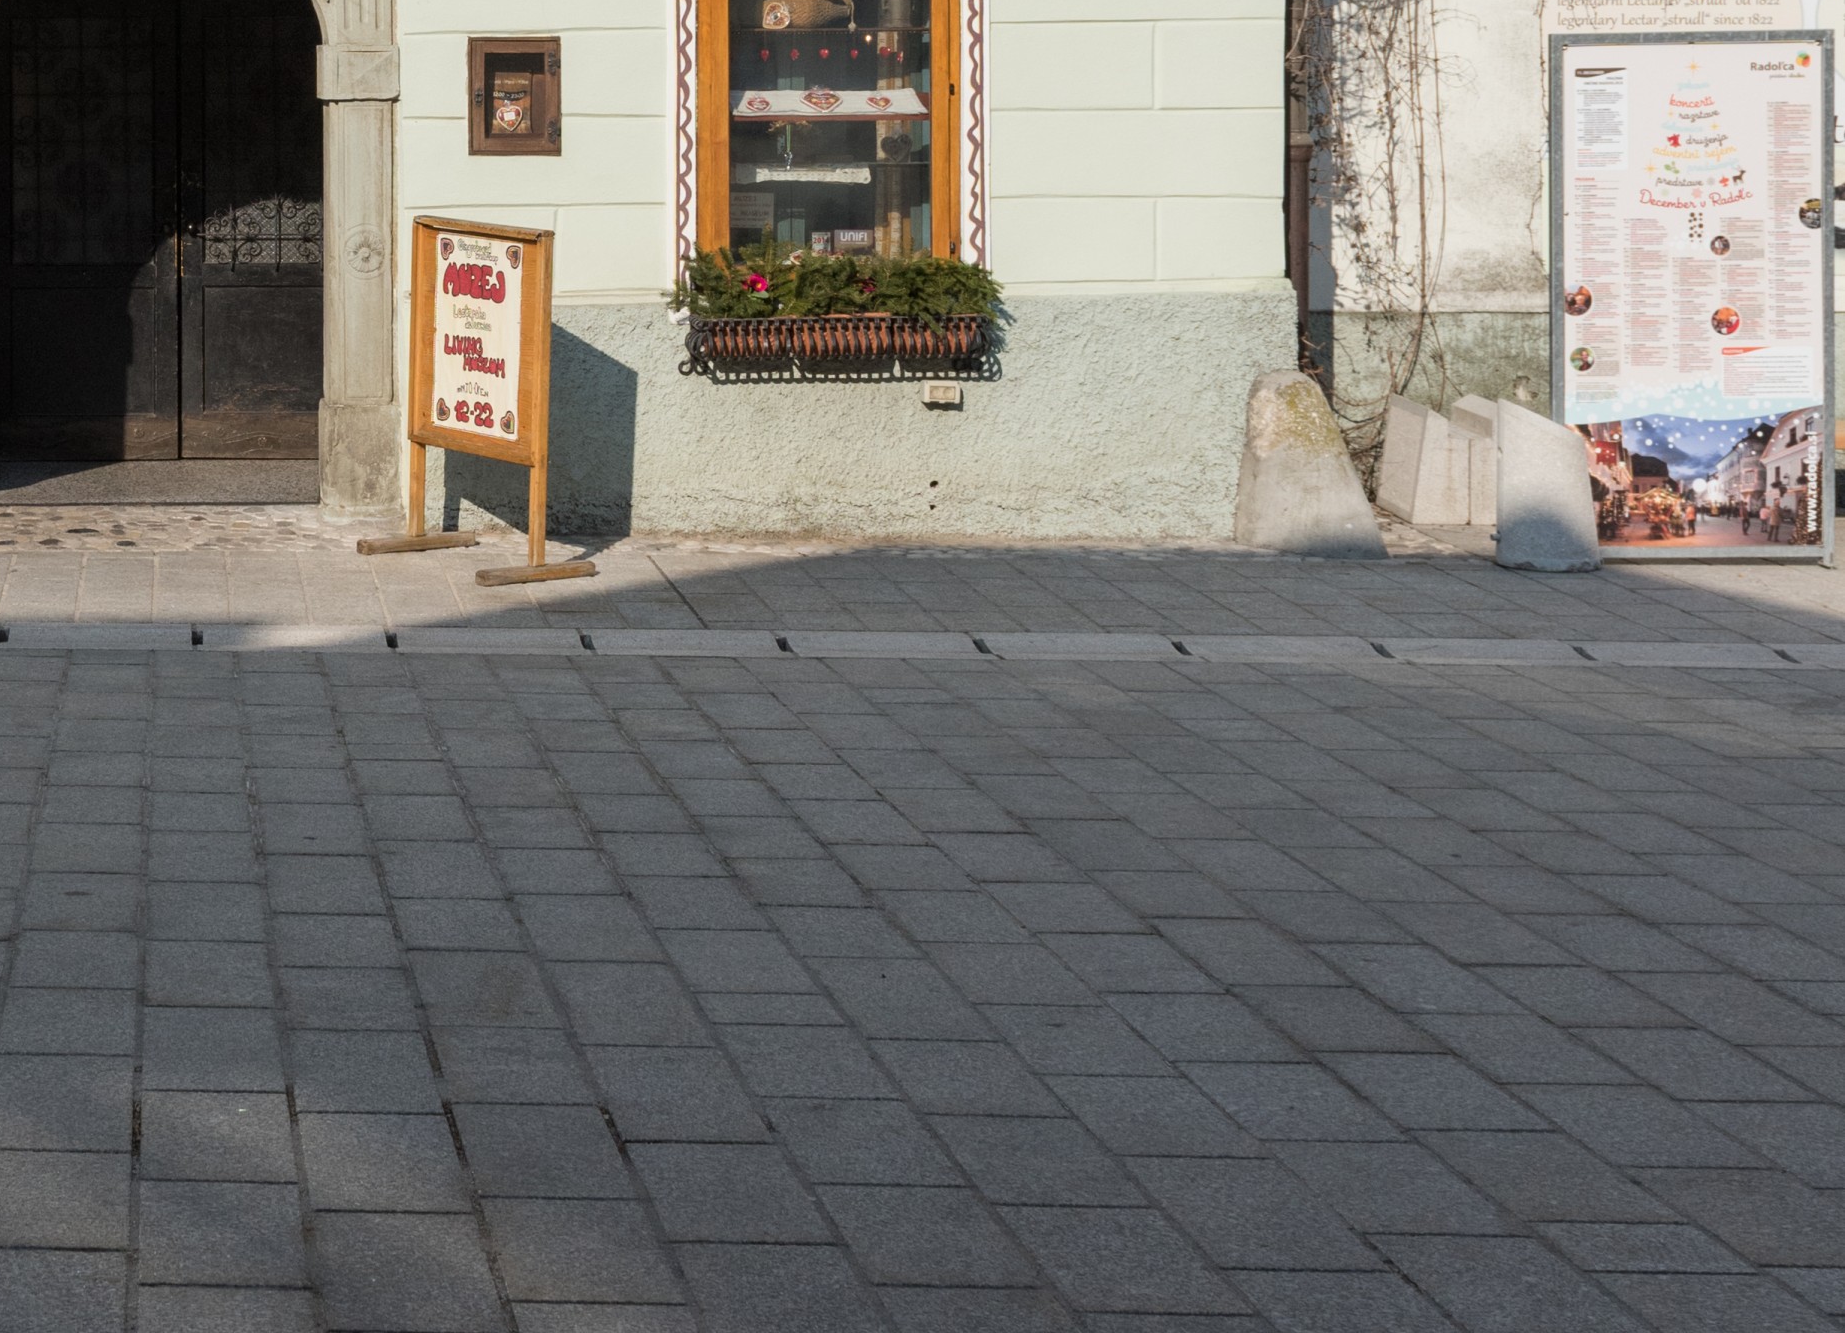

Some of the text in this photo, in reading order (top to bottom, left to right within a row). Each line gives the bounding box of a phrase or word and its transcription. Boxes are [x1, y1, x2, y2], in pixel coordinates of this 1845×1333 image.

[1556, 12, 1617, 30] legendary
[1621, 13, 1657, 26] Lectar
[1713, 13, 1745, 26] since
[1748, 15, 1773, 26] 1822
[1669, 94, 1715, 108] koncerti
[1678, 109, 1720, 123] razstave
[1655, 175, 1704, 187] predstave
[1639, 188, 1697, 209] December
[443, 262, 506, 303] MUZEJ
[444, 333, 483, 356] LIVING
[463, 354, 506, 379] MUSEUM
